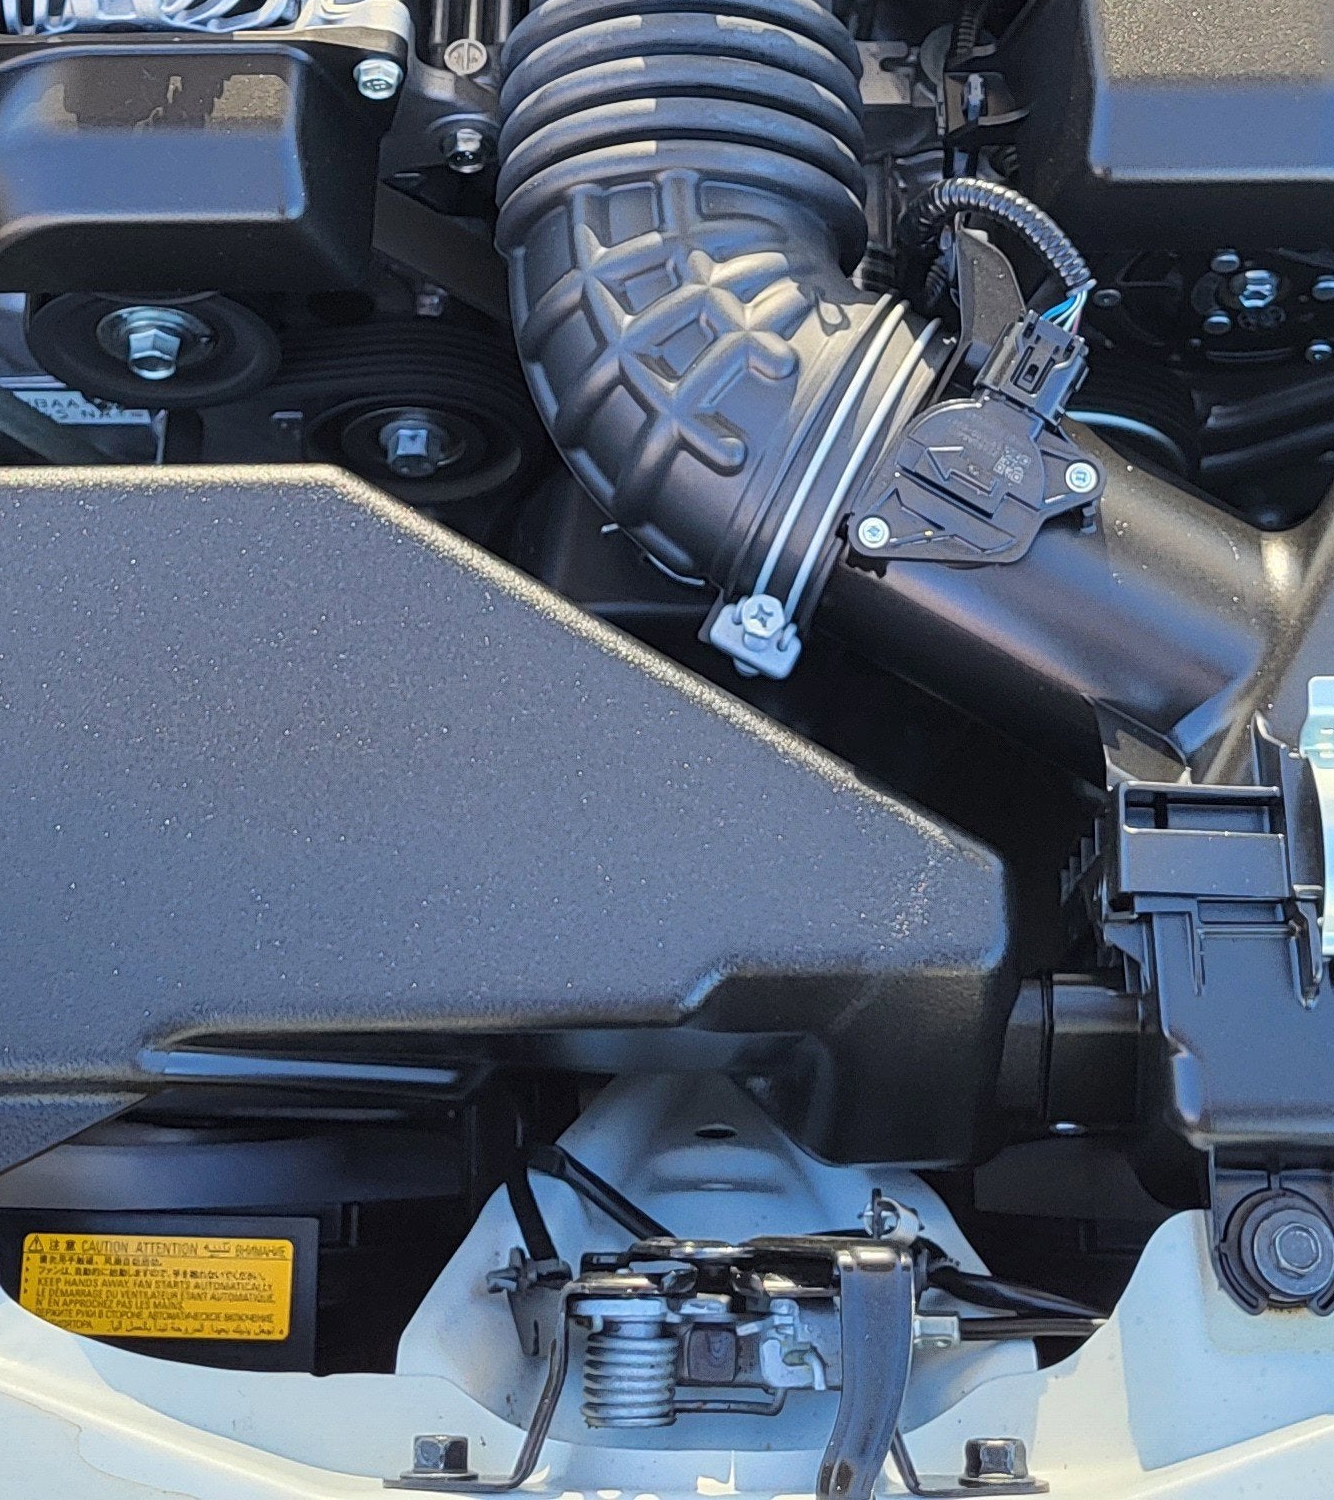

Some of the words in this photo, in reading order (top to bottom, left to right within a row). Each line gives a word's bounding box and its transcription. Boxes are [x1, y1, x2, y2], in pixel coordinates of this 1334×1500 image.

[81, 1239, 130, 1254] CAUTION
[136, 1241, 198, 1256] ATTENTION
[37, 1277, 61, 1288] KEEP
[64, 1278, 99, 1288] HANDS
[133, 1279, 153, 1289] FAN
[61, 1300, 114, 1311] APPROCHEZ
[116, 1301, 134, 1311] PAS
